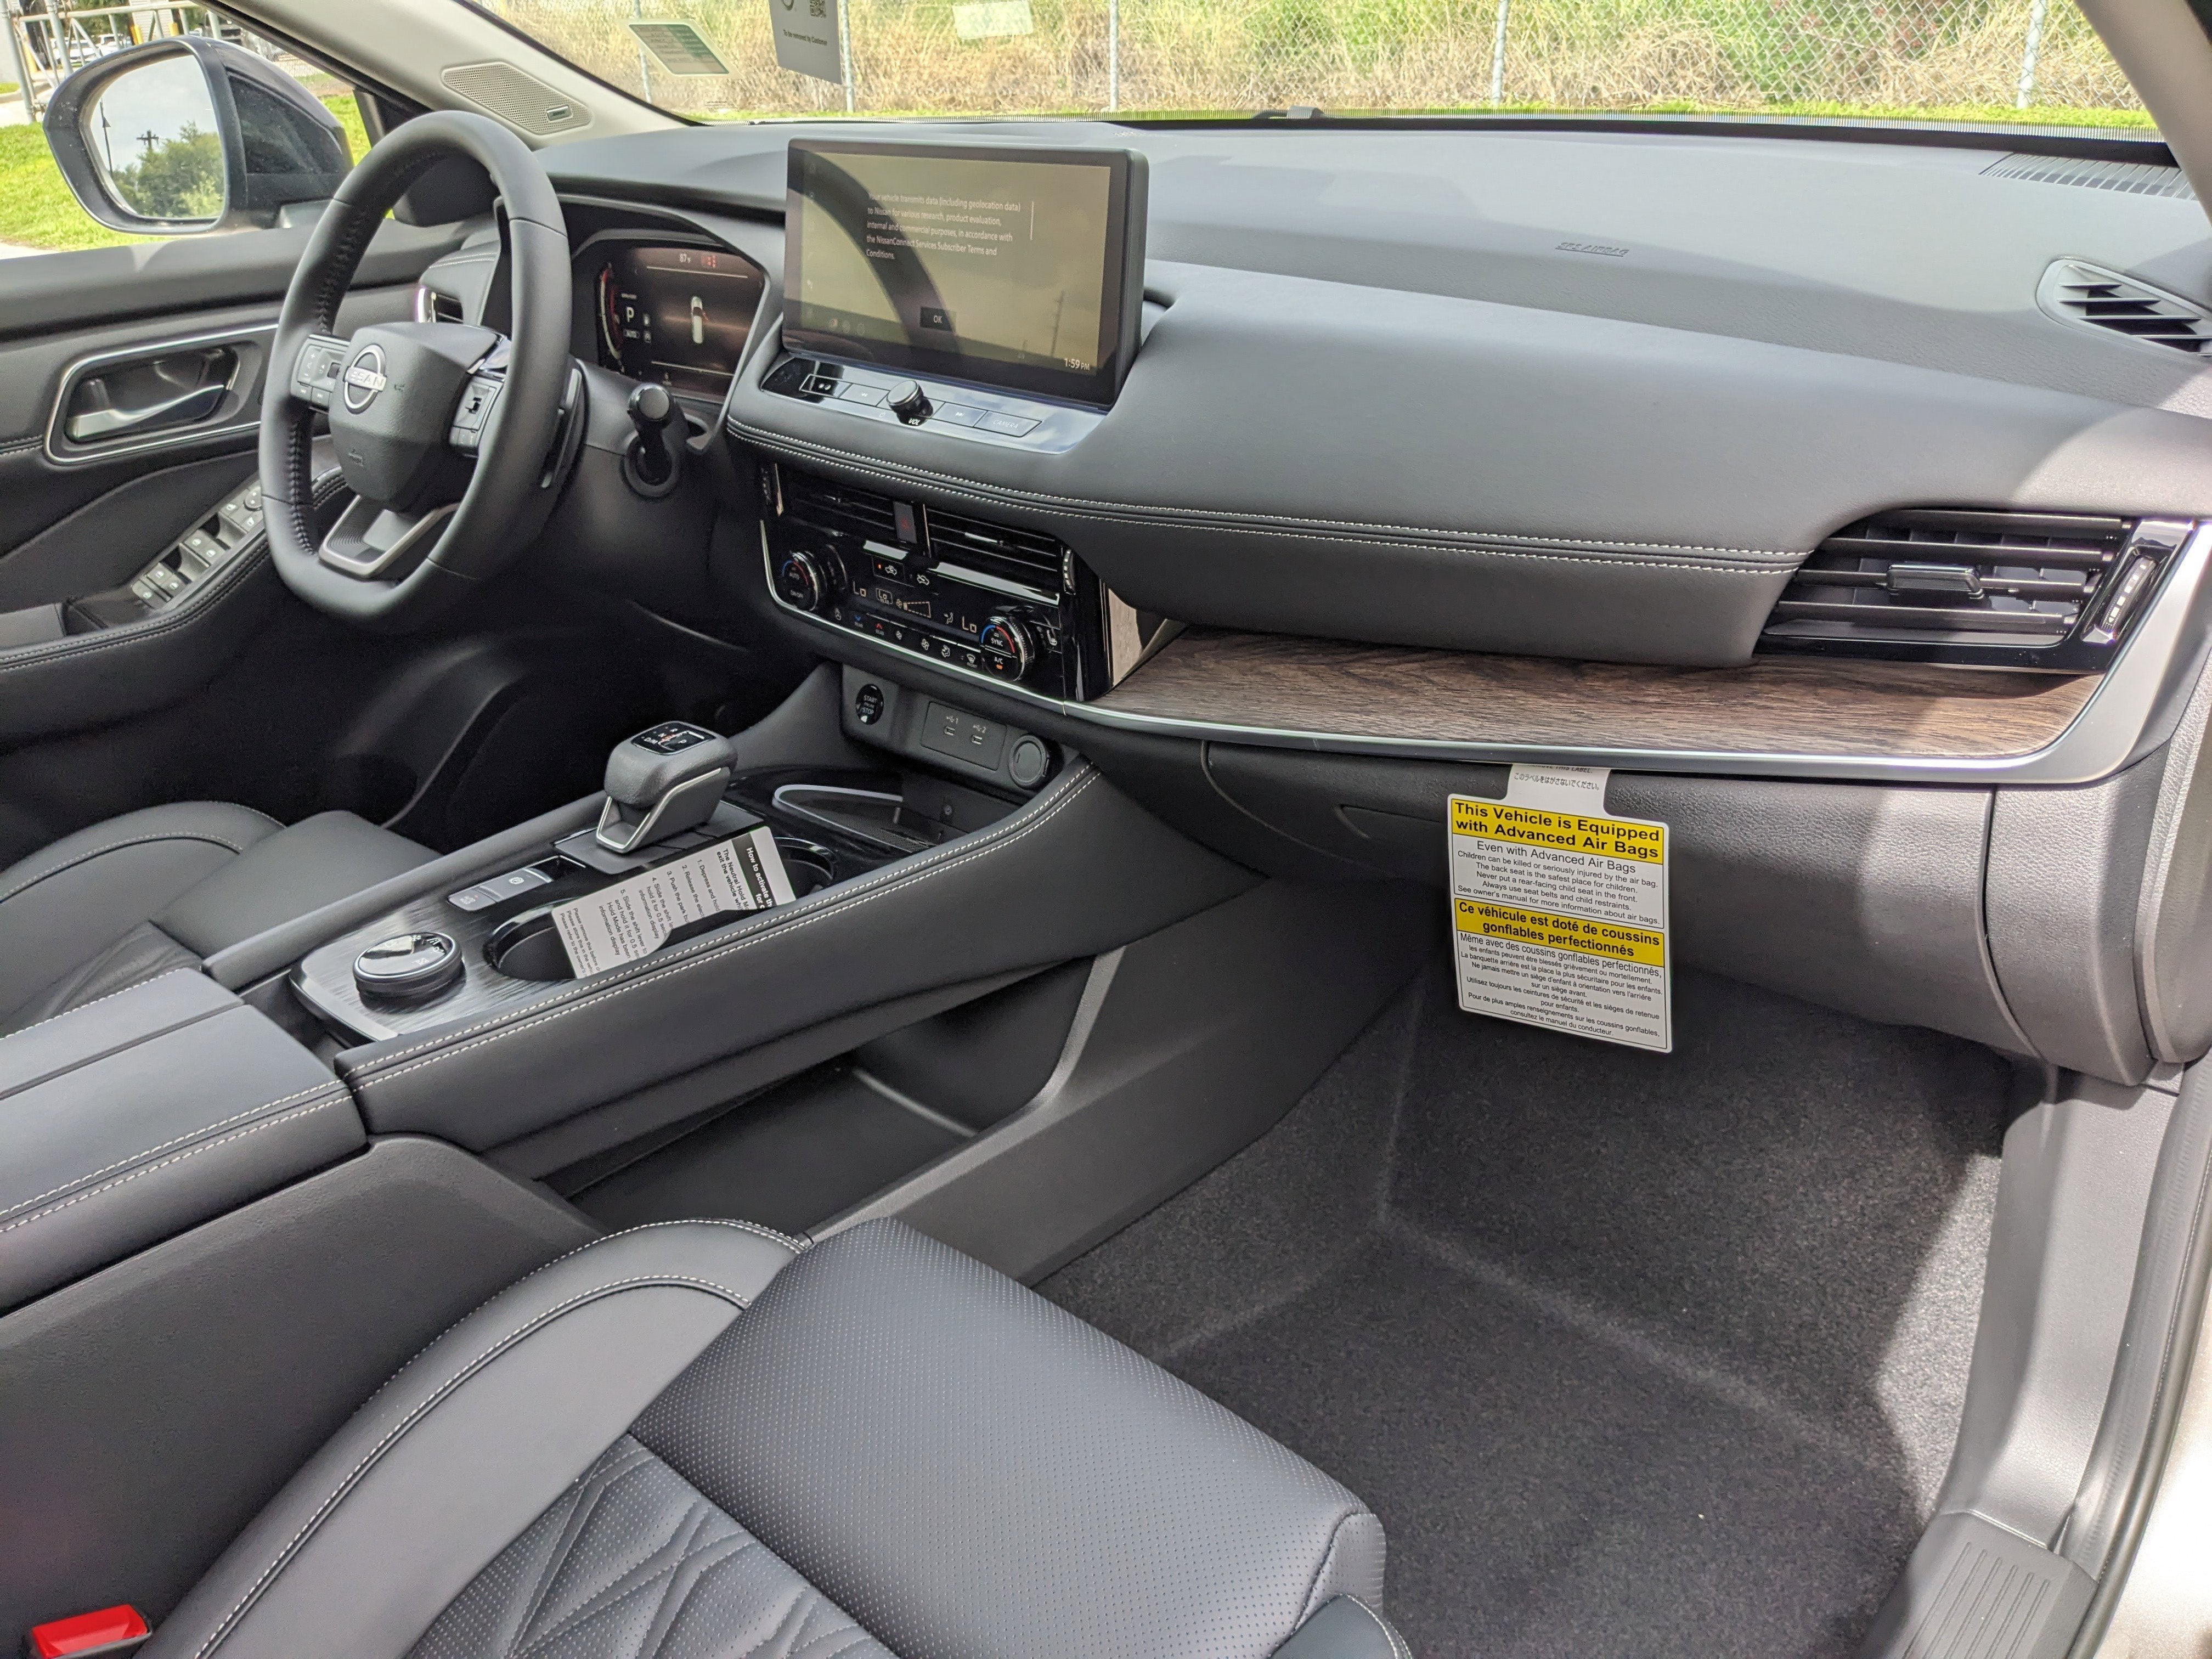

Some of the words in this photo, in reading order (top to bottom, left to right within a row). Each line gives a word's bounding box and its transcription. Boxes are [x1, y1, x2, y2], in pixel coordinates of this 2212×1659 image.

[946, 213, 969, 222] product
[969, 216, 1002, 226] evaluation,
[968, 199, 1003, 210] geolocation
[1005, 202, 1021, 212] data)
[938, 241, 967, 252] Subscriber
[967, 245, 984, 254] Terms
[985, 247, 997, 256] and
[965, 231, 997, 240] accordance
[999, 233, 1013, 242] with
[626, 306, 635, 323] P
[933, 314, 943, 324] OK
[1064, 358, 1080, 369] 1:59
[907, 417, 921, 426] VOL
[992, 419, 1019, 429] CAMERA
[991, 637, 1003, 647] SYNC
[994, 656, 1004, 664] A/C
[864, 695, 877, 703] START
[1454, 801, 1488, 817] This
[1492, 806, 1552, 826] Vehicle
[1558, 815, 1572, 829] is
[1577, 819, 1659, 842] Equipped
[1455, 819, 1488, 833] with
[1493, 823, 1576, 846] Advanced
[1582, 836, 1608, 850] Air
[1614, 840, 1658, 859] Bags
[1457, 849, 1486, 861] Children
[1502, 856, 1511, 865] be
[1513, 858, 1532, 868] killed
[1542, 864, 1575, 876] seriously
[1576, 868, 1602, 879] injured
[1604, 872, 1613, 882] by
[1615, 874, 1627, 883] the
[1641, 878, 1658, 889] bag.
[1476, 839, 1503, 853] Even
[1505, 845, 1527, 857] with
[1530, 848, 1584, 866] Advanced
[1587, 857, 1604, 868] Air
[1606, 859, 1636, 874] Bags
[684, 870, 695, 894] Release
[698, 864, 711, 888] Depress
[707, 888, 716, 899] and
[712, 898, 720, 912] hold
[716, 851, 725, 863] exit
[725, 874, 737, 897] vehicle
[722, 848, 730, 861] The
[726, 861, 740, 885] Neutral
[736, 884, 746, 901] Hold
[746, 847, 756, 863] How
[754, 872, 769, 899] activate
[1475, 861, 1489, 870] The
[1491, 864, 1508, 873] back
[1534, 871, 1546, 879] the
[1547, 874, 1570, 883] safest
[1571, 877, 1592, 886] place
[1593, 879, 1604, 888] for
[1605, 882, 1638, 894] children.
[1476, 870, 1498, 880] Never
[1518, 878, 1557, 891] rear-facing
[1558, 884, 1576, 893] child
[1595, 889, 1602, 897] in
[1604, 890, 1616, 899] the
[1617, 893, 1638, 902] front.
[669, 876, 678, 892] Push
[676, 901, 686, 915] park
[755, 893, 763, 904] for
[1457, 884, 1471, 893] See
[1472, 888, 1500, 898] owner's
[1501, 893, 1527, 902] manual
[1528, 896, 1539, 904] for
[1540, 899, 1559, 907] more
[1560, 901, 1602, 915] information
[1603, 909, 1626, 919] about
[1638, 914, 1660, 925] bags.
[1481, 880, 1507, 891] Always
[1523, 888, 1539, 896] seat
[1540, 889, 1558, 899] belts
[1575, 895, 1593, 904] child
[1594, 899, 1632, 911] restraints.
[622, 895, 631, 911] Slide
[631, 921, 641, 934] shift
[636, 933, 645, 947] lever
[1459, 901, 1475, 914] Ce
[1477, 905, 1527, 923] véhicule
[1530, 916, 1549, 927] est
[1551, 917, 1579, 932] doté
[1582, 922, 1598, 935] de
[1601, 928, 1660, 946] coussins
[1482, 922, 1544, 941] gonflables
[1547, 933, 1634, 957] perfectionnés
[1459, 932, 1483, 945] Même
[1485, 938, 1504, 949] avec
[1505, 940, 1520, 952] des
[1521, 945, 1556, 958] coussins
[1557, 952, 1600, 966] gonflables
[1601, 960, 1662, 979] perfectionnés,
[1509, 1009, 1538, 1020] consultez
[1545, 1017, 1567, 1026] manuel
[1577, 1024, 1613, 1036] conducteur.
